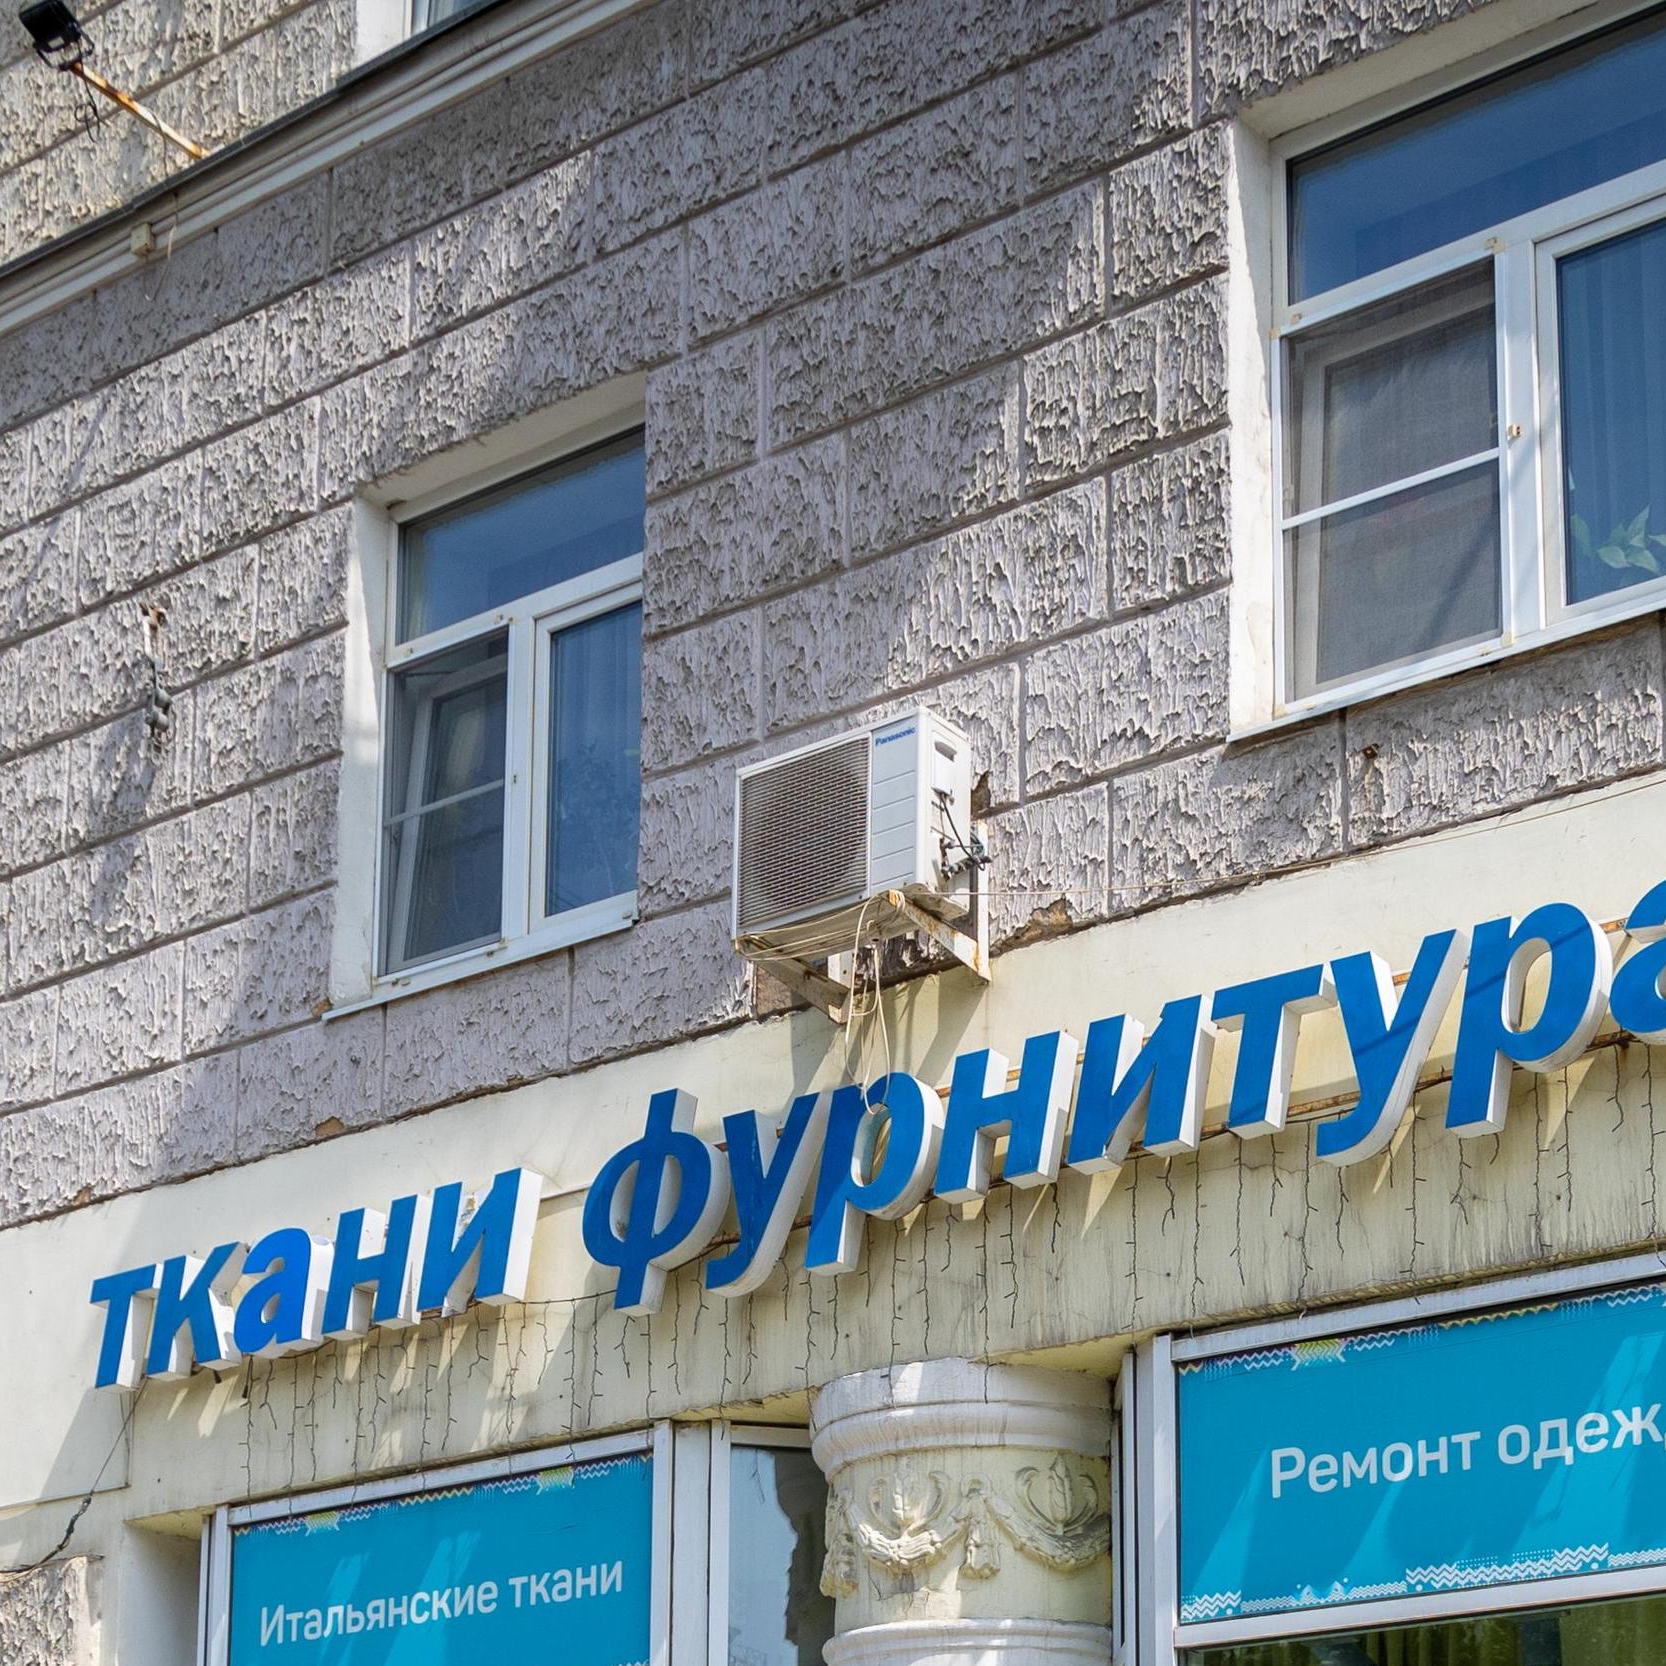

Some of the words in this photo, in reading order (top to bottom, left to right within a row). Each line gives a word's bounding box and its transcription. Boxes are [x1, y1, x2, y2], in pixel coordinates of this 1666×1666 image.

[875, 726, 916, 747] Panasonic
[89, 1168, 533, 1388] ткани
[1271, 1429, 1481, 1498] Ремонт
[259, 1581, 498, 1647] Итальянские
[508, 1560, 623, 1607] ткани
